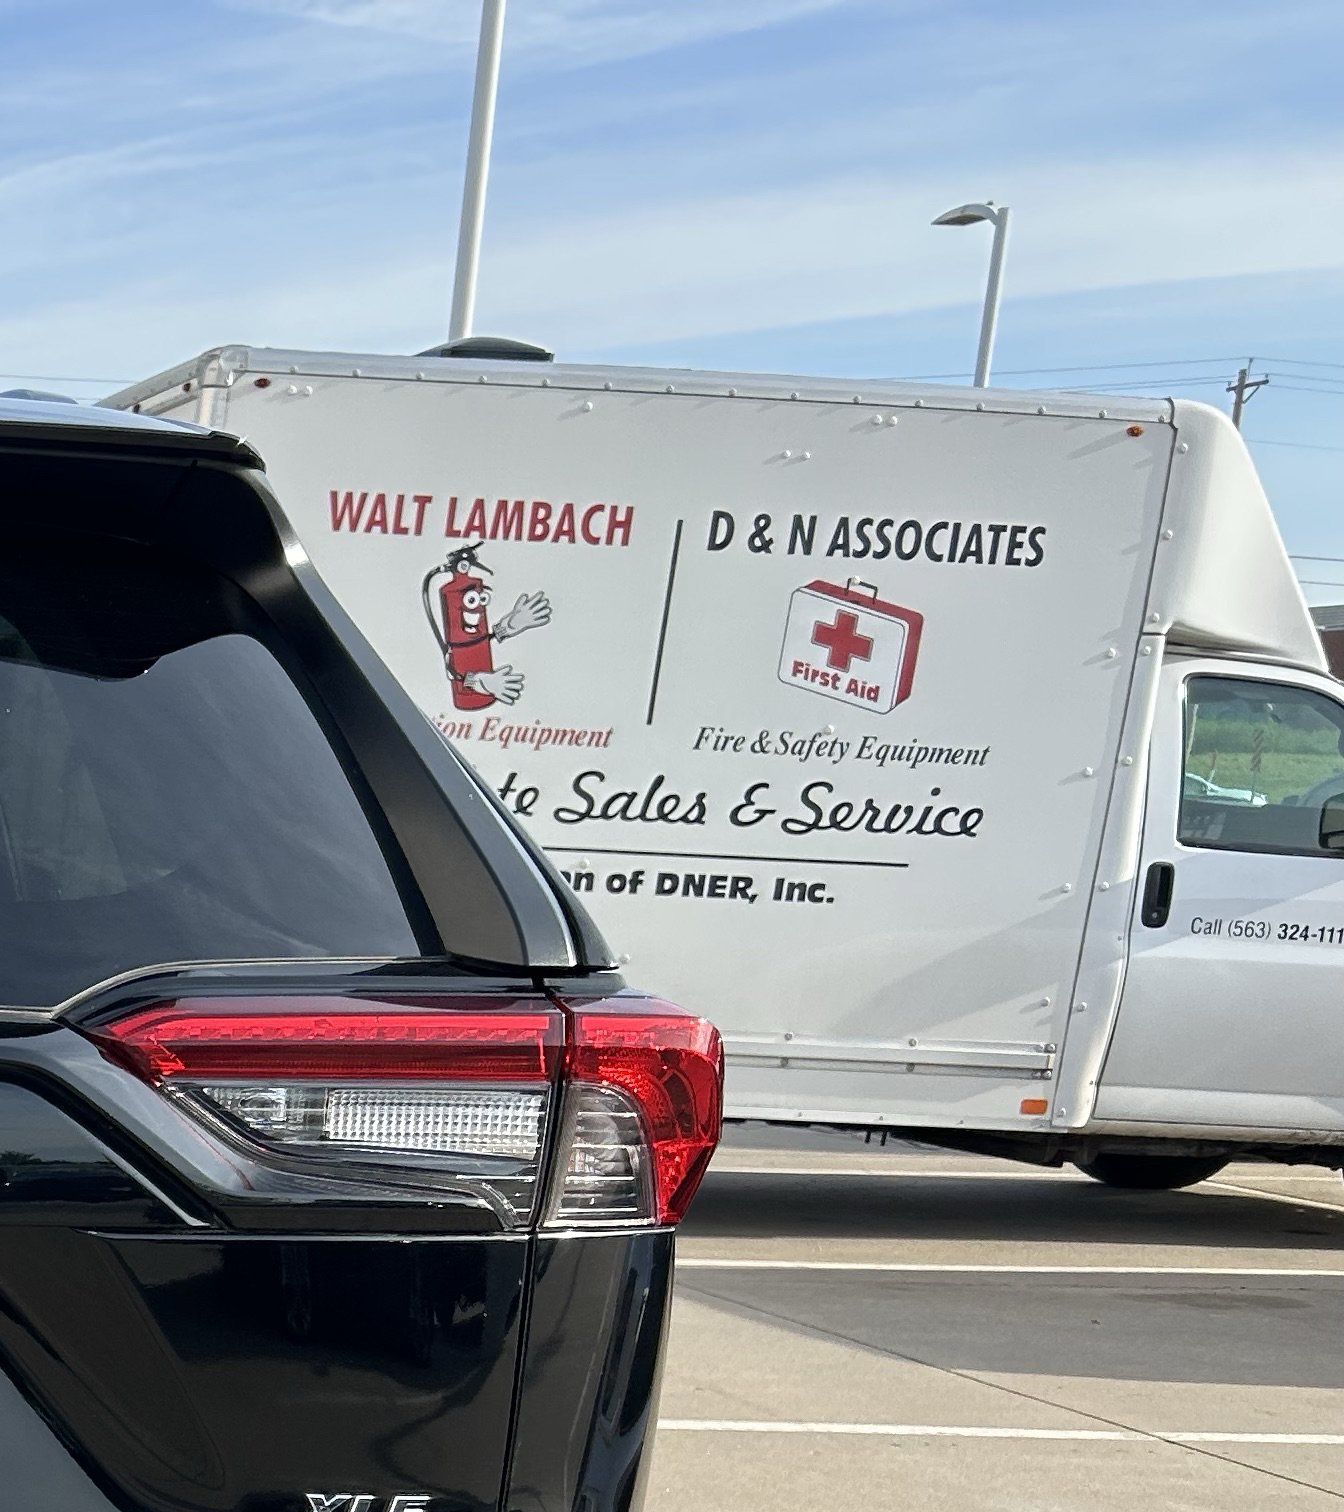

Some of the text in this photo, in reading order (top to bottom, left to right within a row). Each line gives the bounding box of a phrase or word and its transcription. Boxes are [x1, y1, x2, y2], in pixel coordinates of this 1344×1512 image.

[329, 490, 634, 547] WALT LAMBACH
[707, 510, 1047, 567] D & N ASSOCIATES
[791, 660, 881, 702] First Aid
[478, 716, 614, 751] Equipment
[693, 726, 746, 753] Fire
[855, 735, 991, 769] Equipment
[553, 770, 707, 826] Sales
[729, 781, 777, 827] &
[780, 780, 984, 838] Service
[606, 870, 645, 894] of
[655, 871, 758, 904] DNER,
[772, 876, 835, 904] Inc.
[1190, 916, 1223, 936] Call
[1227, 919, 1272, 940] (563)
